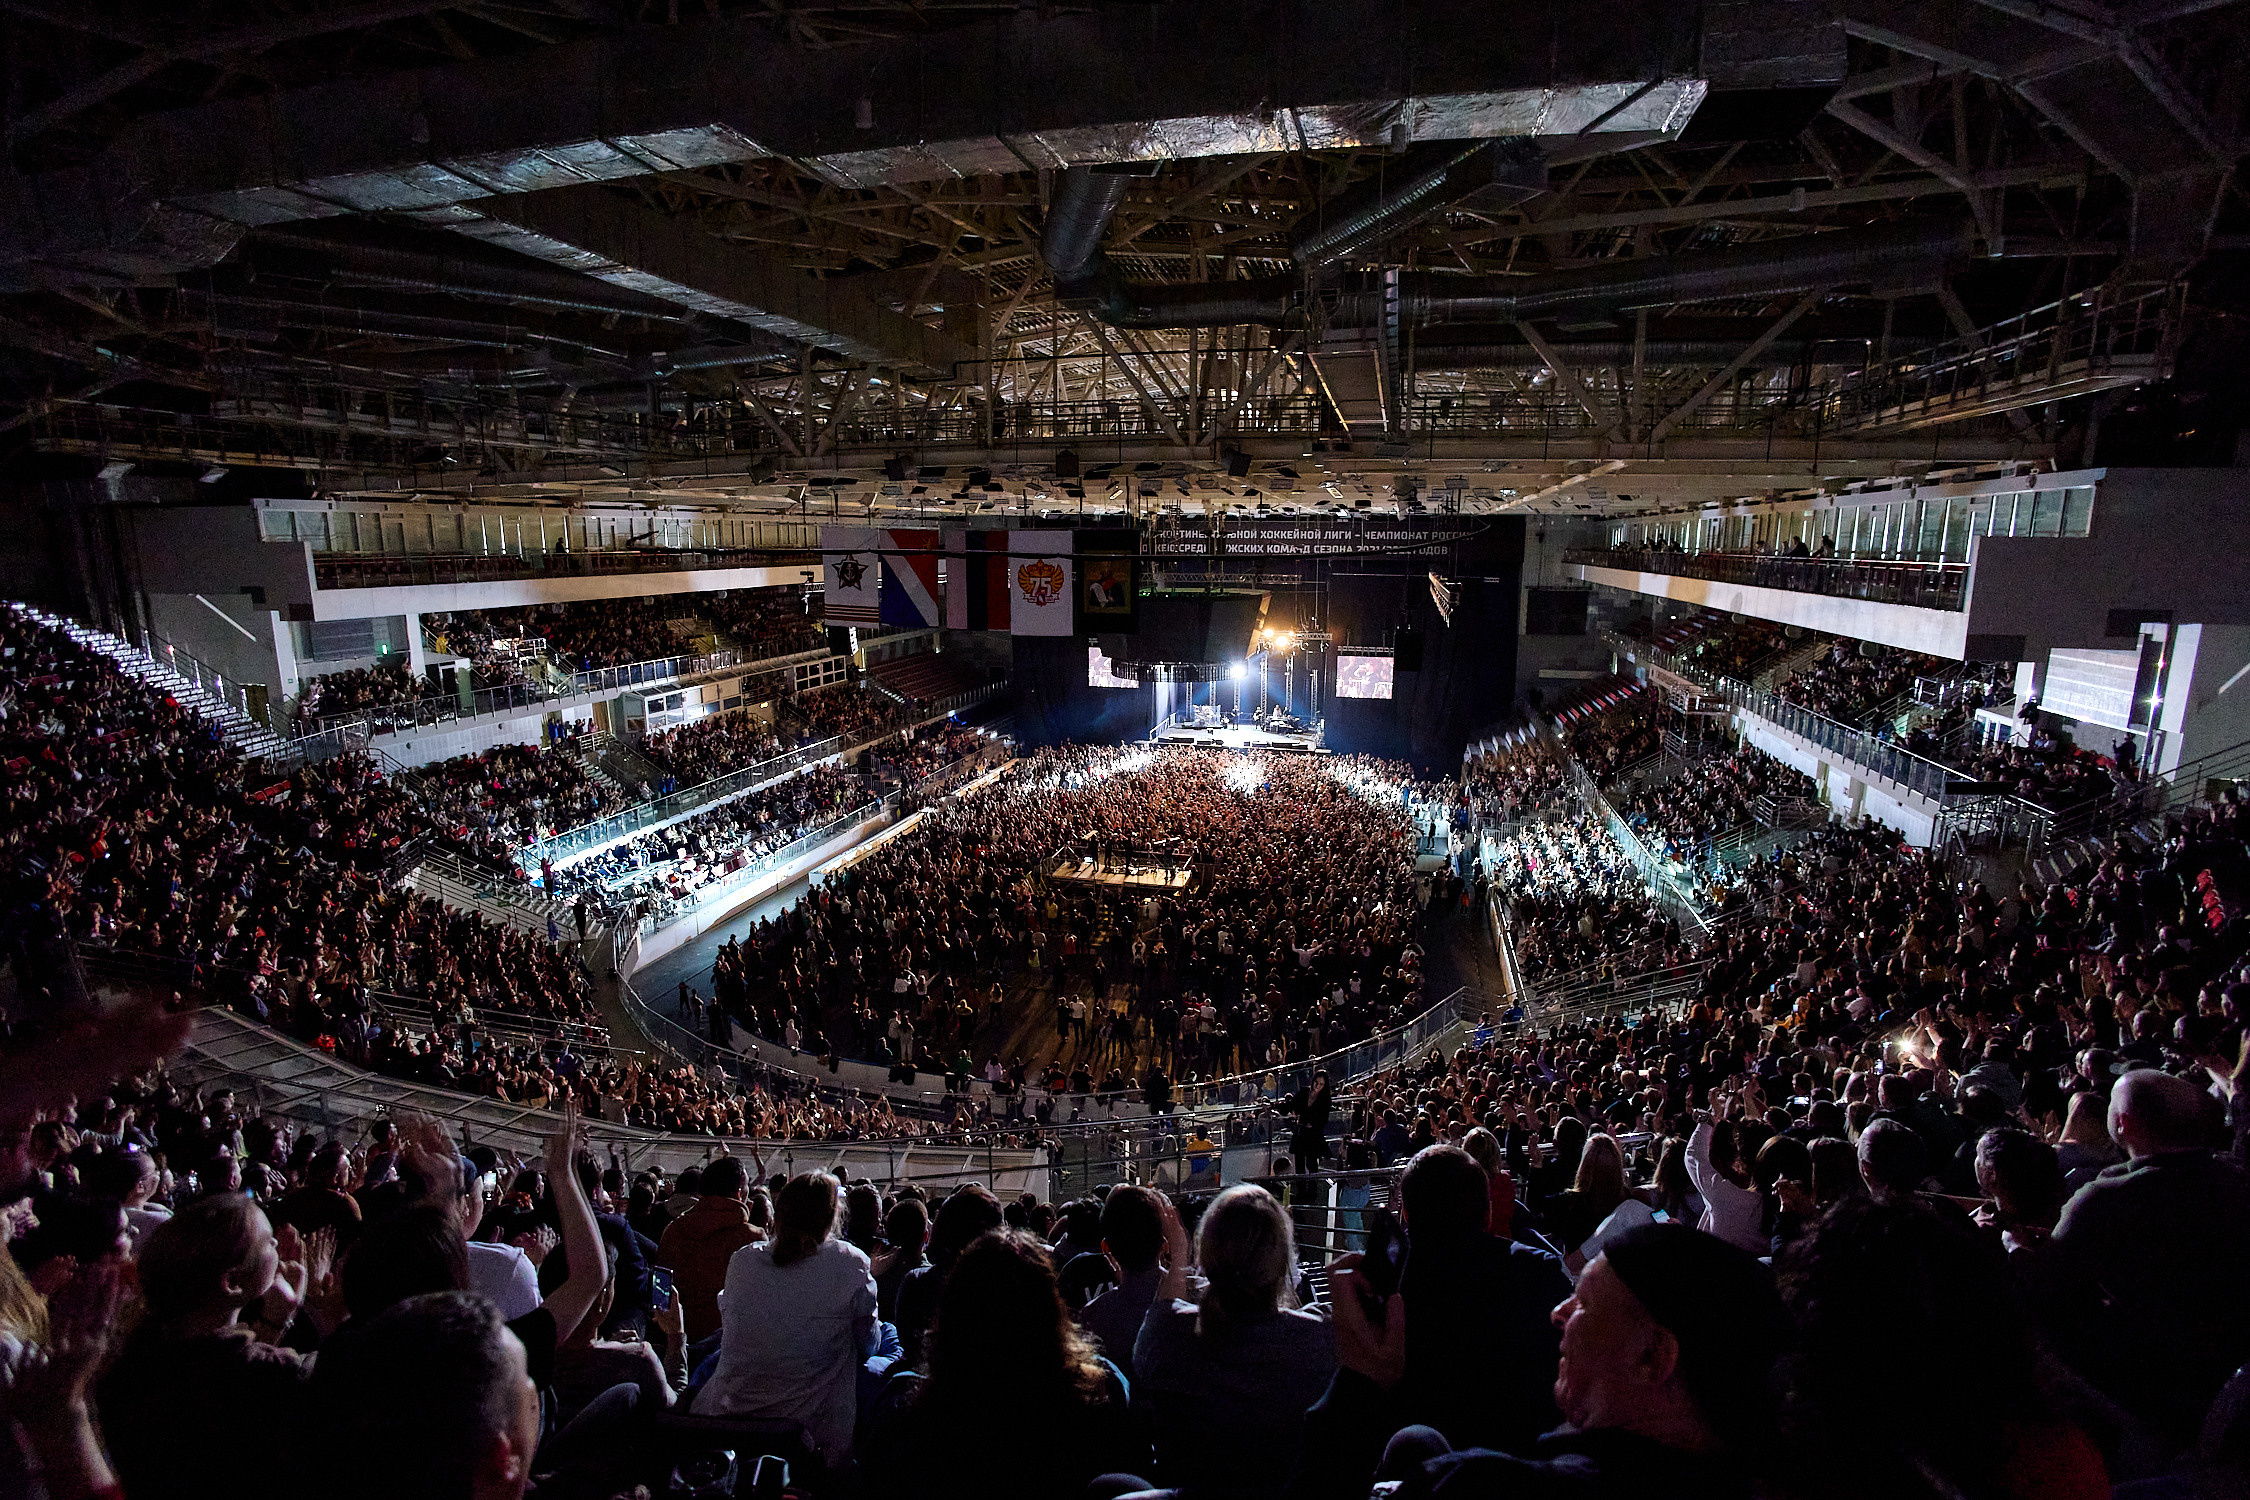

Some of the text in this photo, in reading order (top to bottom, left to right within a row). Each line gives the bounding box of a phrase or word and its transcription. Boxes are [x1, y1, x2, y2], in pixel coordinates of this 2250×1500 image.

[1161, 529, 1257, 539] КОНТИНЕЬНОЙ
[1260, 528, 1321, 540] ХОККЕЙНОЙ
[1324, 530, 1352, 540] ЛИГИ
[1364, 530, 1429, 540] ЧЕМПИОНАТ
[1313, 544, 1353, 554] СЕЗОНА
[1030, 577, 1052, 597] 75
